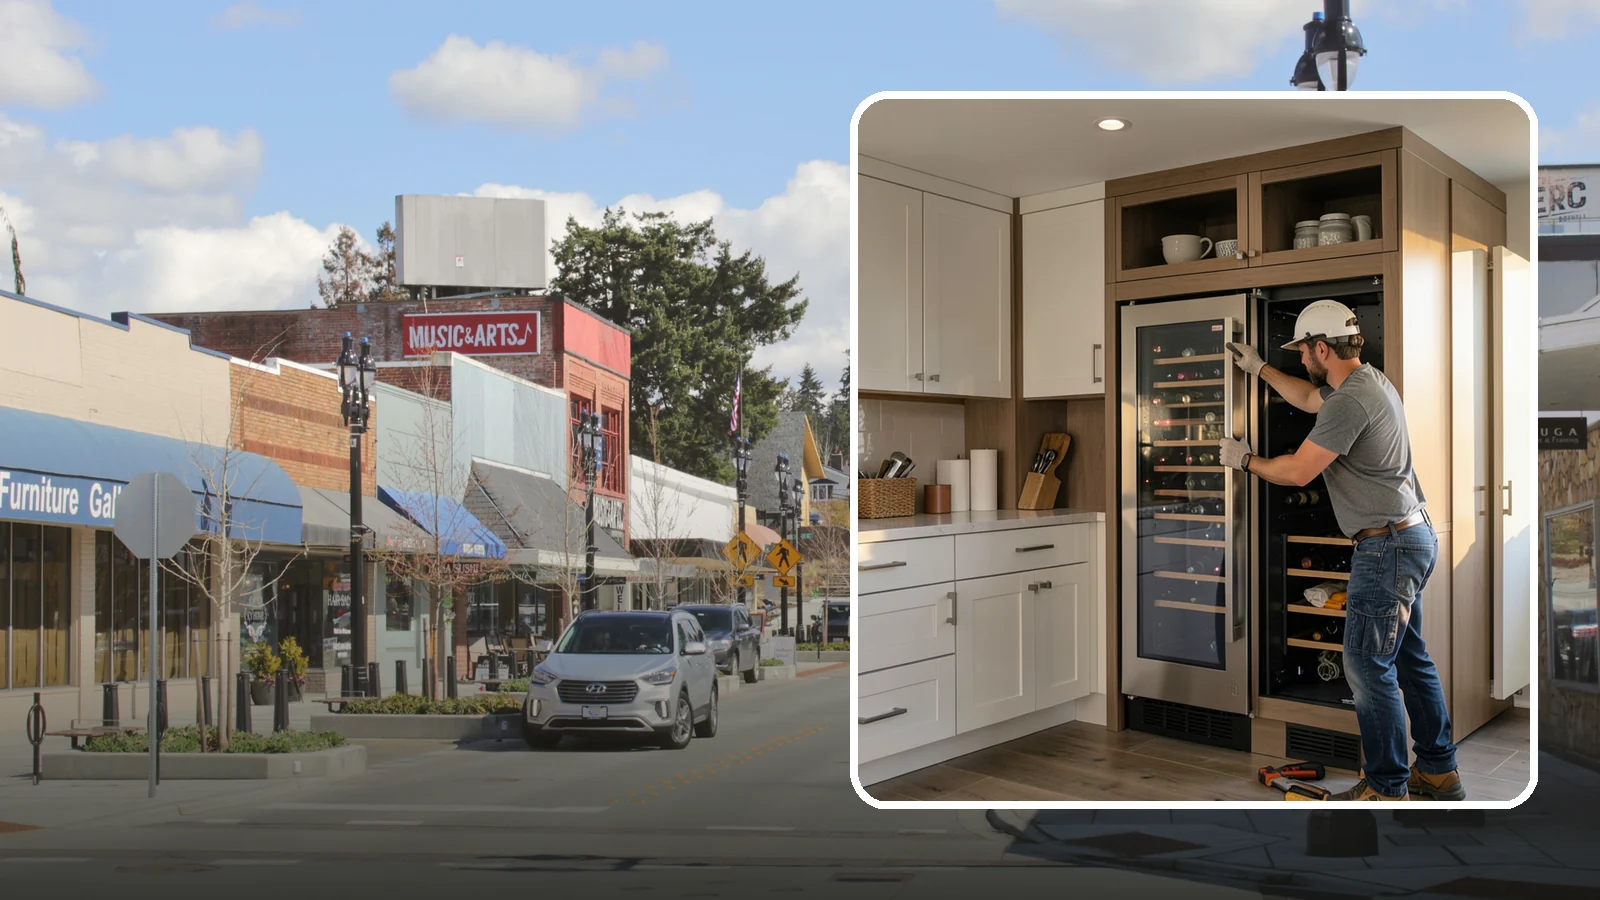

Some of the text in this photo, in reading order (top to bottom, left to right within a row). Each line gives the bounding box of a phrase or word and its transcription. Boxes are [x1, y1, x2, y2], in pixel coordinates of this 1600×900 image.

[1538, 181, 1587, 213] ERC
[1540, 427, 1578, 436] UGA
[0, 471, 121, 519] Furniture Gal
